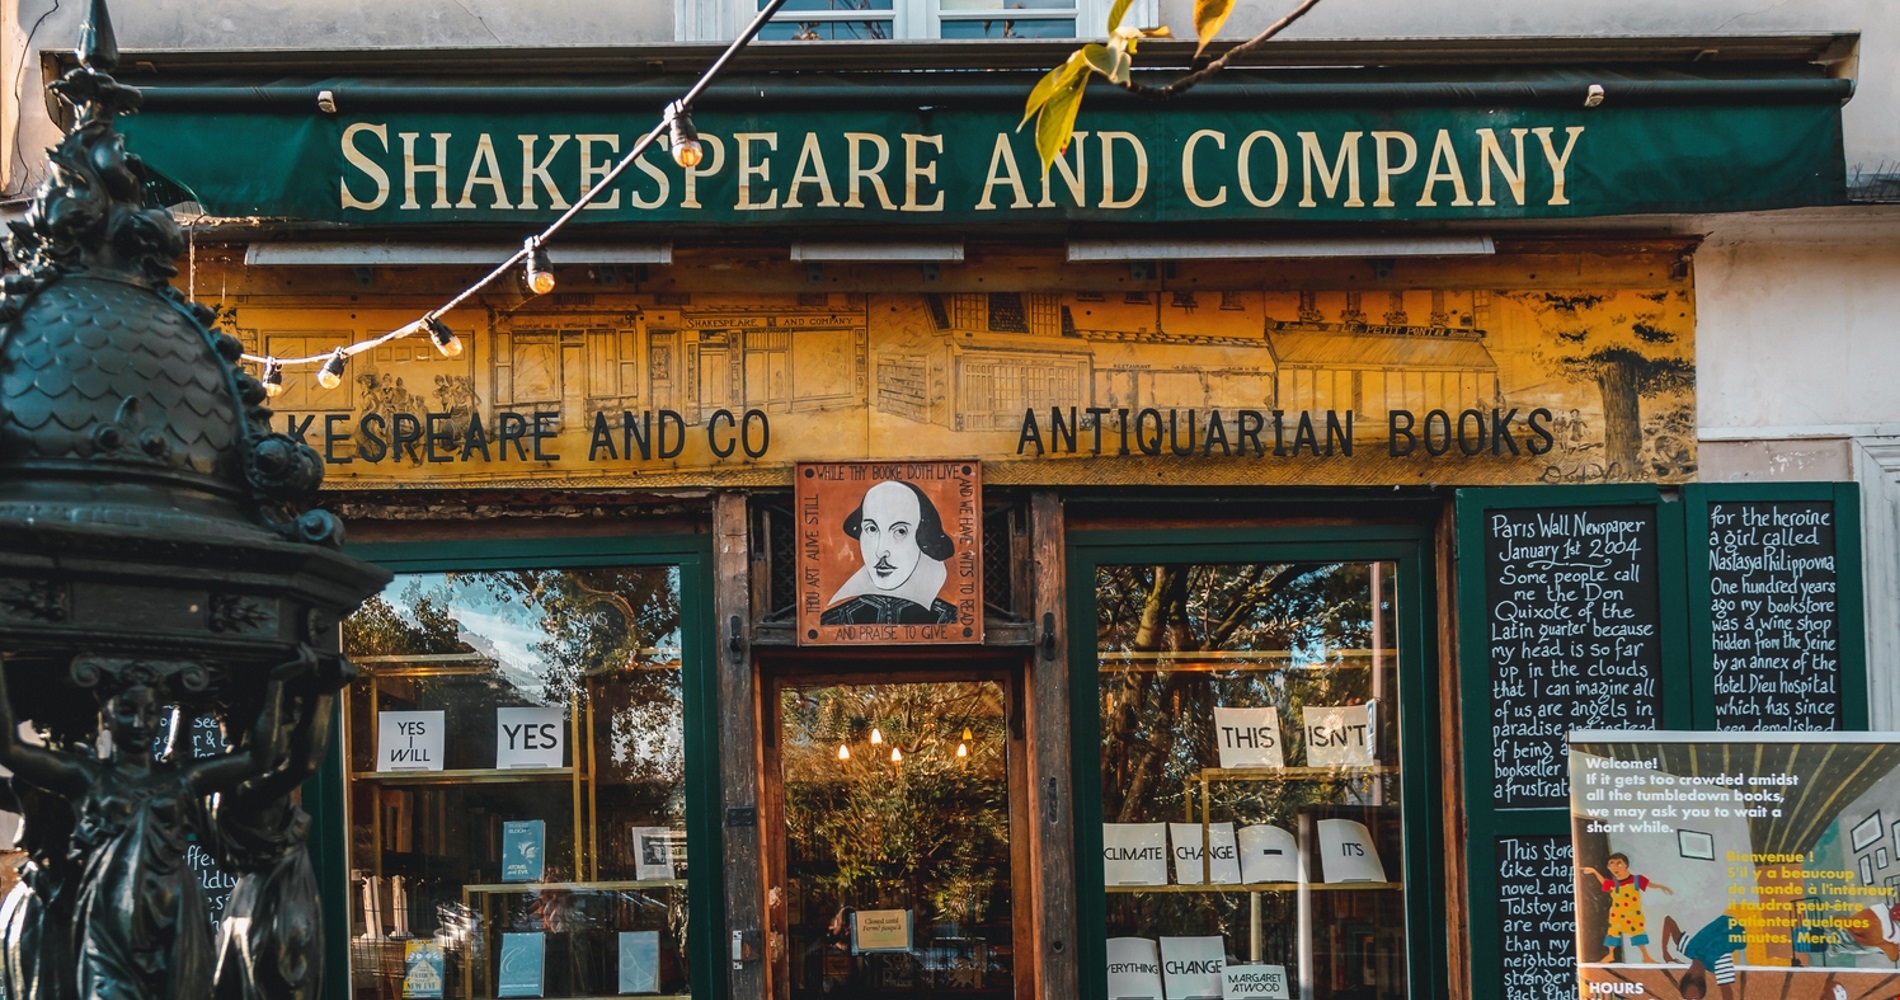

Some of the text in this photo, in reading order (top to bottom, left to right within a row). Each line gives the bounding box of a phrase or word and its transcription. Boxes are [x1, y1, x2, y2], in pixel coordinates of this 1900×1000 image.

[340, 122, 1585, 212] SHAKESPEARE AND COMPANY
[687, 319, 757, 328] SHAKESPEARE
[784, 318, 804, 326] AND
[1366, 326, 1399, 334] PETIT
[588, 410, 686, 462] AND
[709, 408, 770, 459] CO
[1016, 406, 1553, 457] ANTIQUARIAN BOOKS
[815, 464, 960, 481] WHILE THY BOOKE DOTH LIVE
[1710, 505, 1830, 528] for the heroine
[1492, 512, 1645, 543] Paris Wall Newspaper
[1709, 526, 1820, 553] a girl called
[804, 494, 820, 615] THOU ART STILL
[959, 479, 974, 626] AND WE HAVE WITS TO READ
[1563, 538, 1641, 560] 1st 2004
[1709, 546, 1762, 577] Nastasya
[1500, 564, 1640, 590] Some people call
[1514, 583, 1624, 601] me the Don
[1711, 575, 1836, 601] One hundred years
[1495, 601, 1635, 623] Quixote the
[1741, 595, 1835, 613] my bookstore
[835, 626, 948, 640] AND PRAISE TO GIVE
[1492, 618, 1654, 643] Latin quarter because
[1712, 616, 1832, 638] was wine shop
[1492, 637, 1644, 665] my head is so far
[1712, 628, 1836, 656] hidden from the Seine
[1730, 653, 1837, 671] an annex the
[1499, 659, 1648, 684] up in the clouds
[1493, 678, 1655, 704] that can imagine all
[1714, 671, 1837, 699] Hotel Dieu hospital
[1494, 698, 1653, 724] of us are angels in
[1716, 696, 1835, 715] which has since
[397, 721, 425, 735] YES
[502, 723, 558, 750] YES
[1308, 724, 1367, 747] ISN'T
[1222, 726, 1275, 749] THIS
[390, 748, 431, 762] WILL
[1514, 741, 1554, 764] being
[1494, 760, 1561, 779] bookseller
[1585, 758, 1658, 769] Welcome!
[1586, 773, 1799, 788] If it gets too crowded amidst
[1586, 789, 1785, 804] all the tumbledown books,
[1586, 805, 1782, 820] we may ask you to wait a
[1586, 820, 1674, 833] short while.
[1103, 847, 1162, 861] CLIMATE
[1176, 846, 1235, 860] CHANGE
[1342, 843, 1364, 857] IT'S
[1500, 839, 1538, 861] This
[1727, 851, 1805, 862] Bienvenue
[1500, 861, 1536, 877] like
[1728, 866, 1855, 882] S'il beaucoup
[1502, 879, 1543, 895] novel
[1728, 883, 1746, 895] de
[1751, 883, 1803, 895] monde
[1500, 897, 1557, 920] Tolstoy
[1741, 899, 1864, 914] faudra peut-être
[1503, 920, 1533, 932] are
[1728, 917, 1870, 930] patienter quelques
[1505, 935, 1570, 955] than my
[1728, 932, 1842, 944] minutes. Merci.
[1166, 959, 1222, 974] CHANGE
[1228, 973, 1282, 983] MARGARET
[1231, 982, 1280, 992] ATWOOD
[1589, 983, 1644, 994] HOURS
